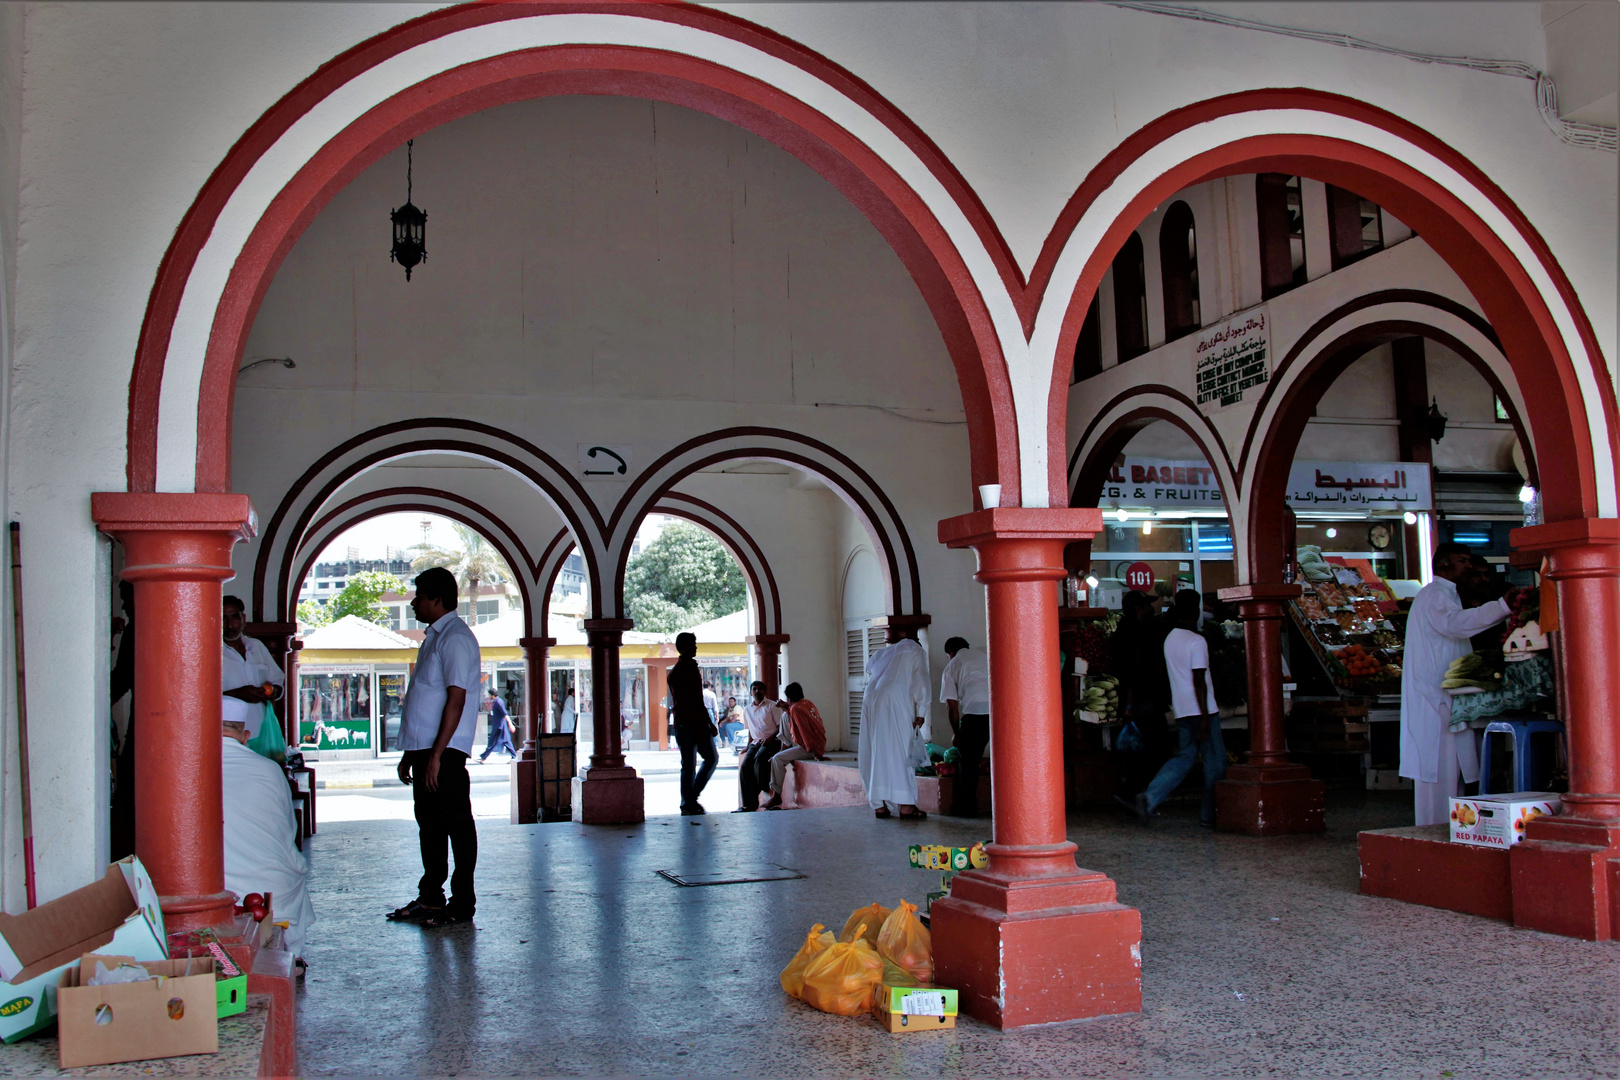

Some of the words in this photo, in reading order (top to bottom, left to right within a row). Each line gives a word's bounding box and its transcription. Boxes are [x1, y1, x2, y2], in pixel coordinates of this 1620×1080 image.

[1246, 319, 1259, 329] حالة
[1230, 326, 1246, 338] وجود
[1248, 335, 1266, 350] مراجعة
[1202, 367, 1216, 381] CASE
[1216, 364, 1223, 376] OF
[1223, 360, 1234, 374] ANY
[1197, 378, 1217, 394] PLEASE
[1217, 369, 1241, 387] CONTACT
[1212, 385, 1230, 401] OFFICE
[1230, 382, 1237, 394] AT
[1220, 391, 1243, 407] MARKET
[1131, 465, 1212, 486] BASEET
[1314, 469, 1407, 491] البسيط
[1133, 488, 1147, 499] &
[1154, 488, 1222, 501] FRUITS
[1294, 491, 1347, 504] والفواكة
[1350, 492, 1418, 503] للخضروات
[1129, 571, 1151, 586] 101
[1456, 832, 1471, 840] RED
[1473, 834, 1504, 845] PAPAYA
[0, 998, 32, 1016] MAFA
